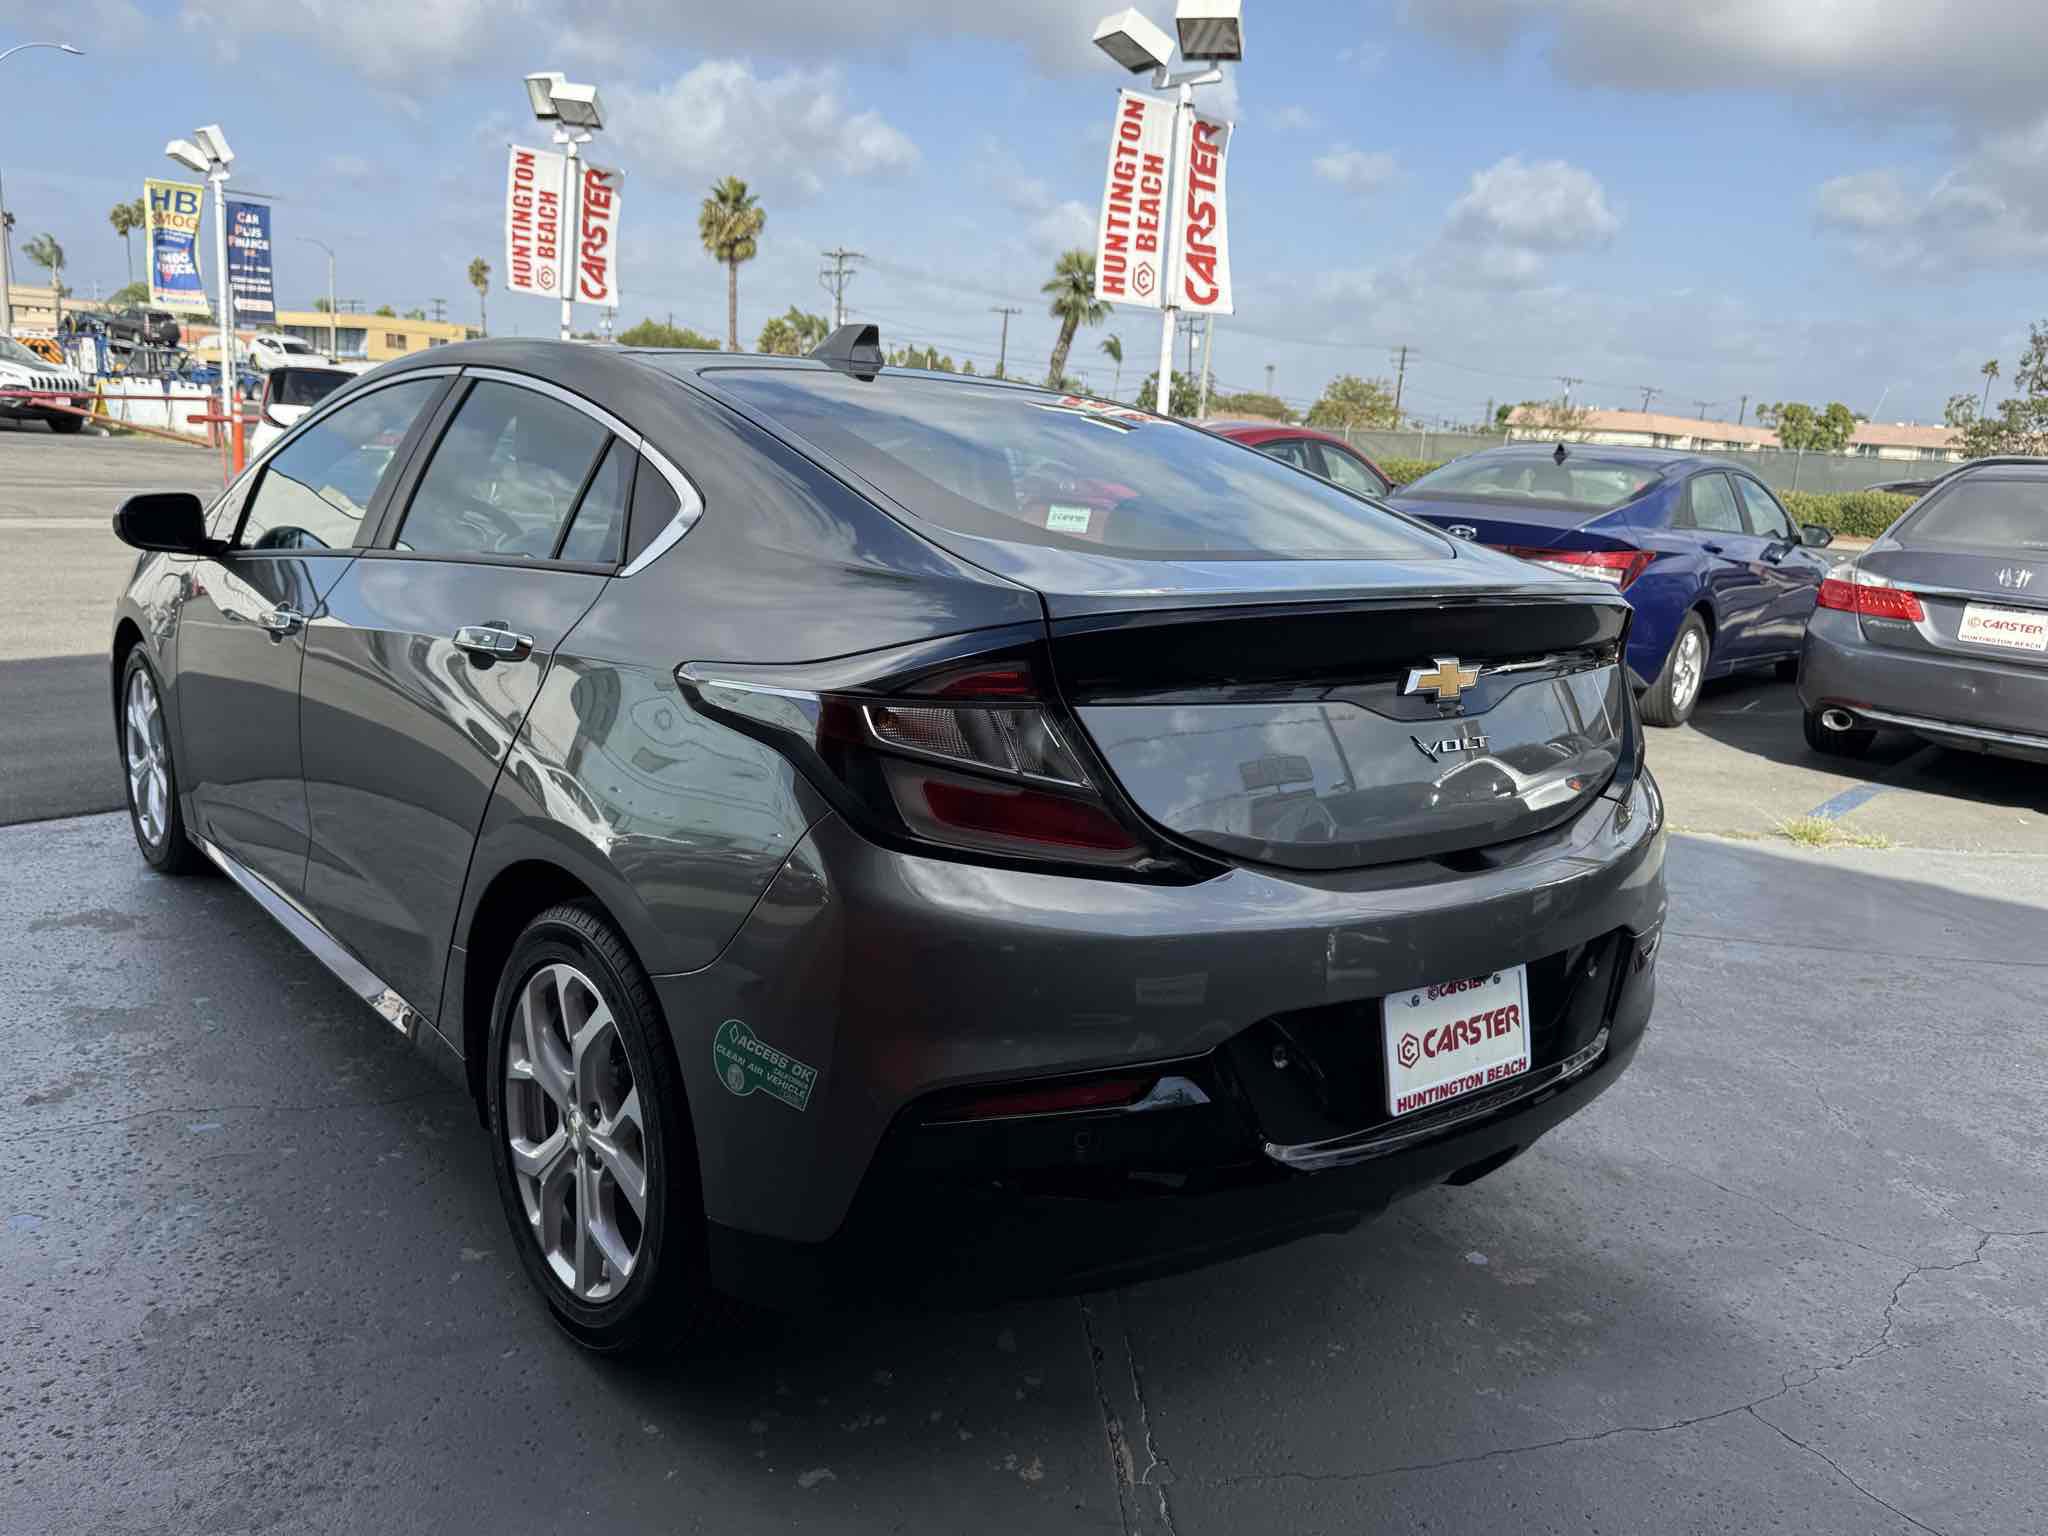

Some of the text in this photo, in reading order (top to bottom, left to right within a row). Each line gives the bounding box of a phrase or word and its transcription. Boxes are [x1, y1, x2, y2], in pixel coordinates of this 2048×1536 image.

[150, 189, 197, 214] HB
[512, 152, 535, 287] HUNTINGTON
[537, 190, 558, 260] BEACH
[1103, 99, 1146, 296] HUNTINGTON
[1136, 153, 1164, 252] BEACH
[1185, 120, 1221, 305] CARSTER
[580, 168, 614, 299] CARSTER
[1982, 618, 2044, 635] CARSTER
[1409, 735, 1491, 763] VOLT
[737, 1035, 789, 1069] ACCESS
[791, 1063, 813, 1081] OK
[1423, 1003, 1521, 1058] CARSTER
[716, 1043, 746, 1065] CLEAN
[747, 1063, 764, 1077] AIR
[767, 1072, 807, 1099] VEHICLE
[1397, 1057, 1527, 1113] HUNTINGTON BEACH
